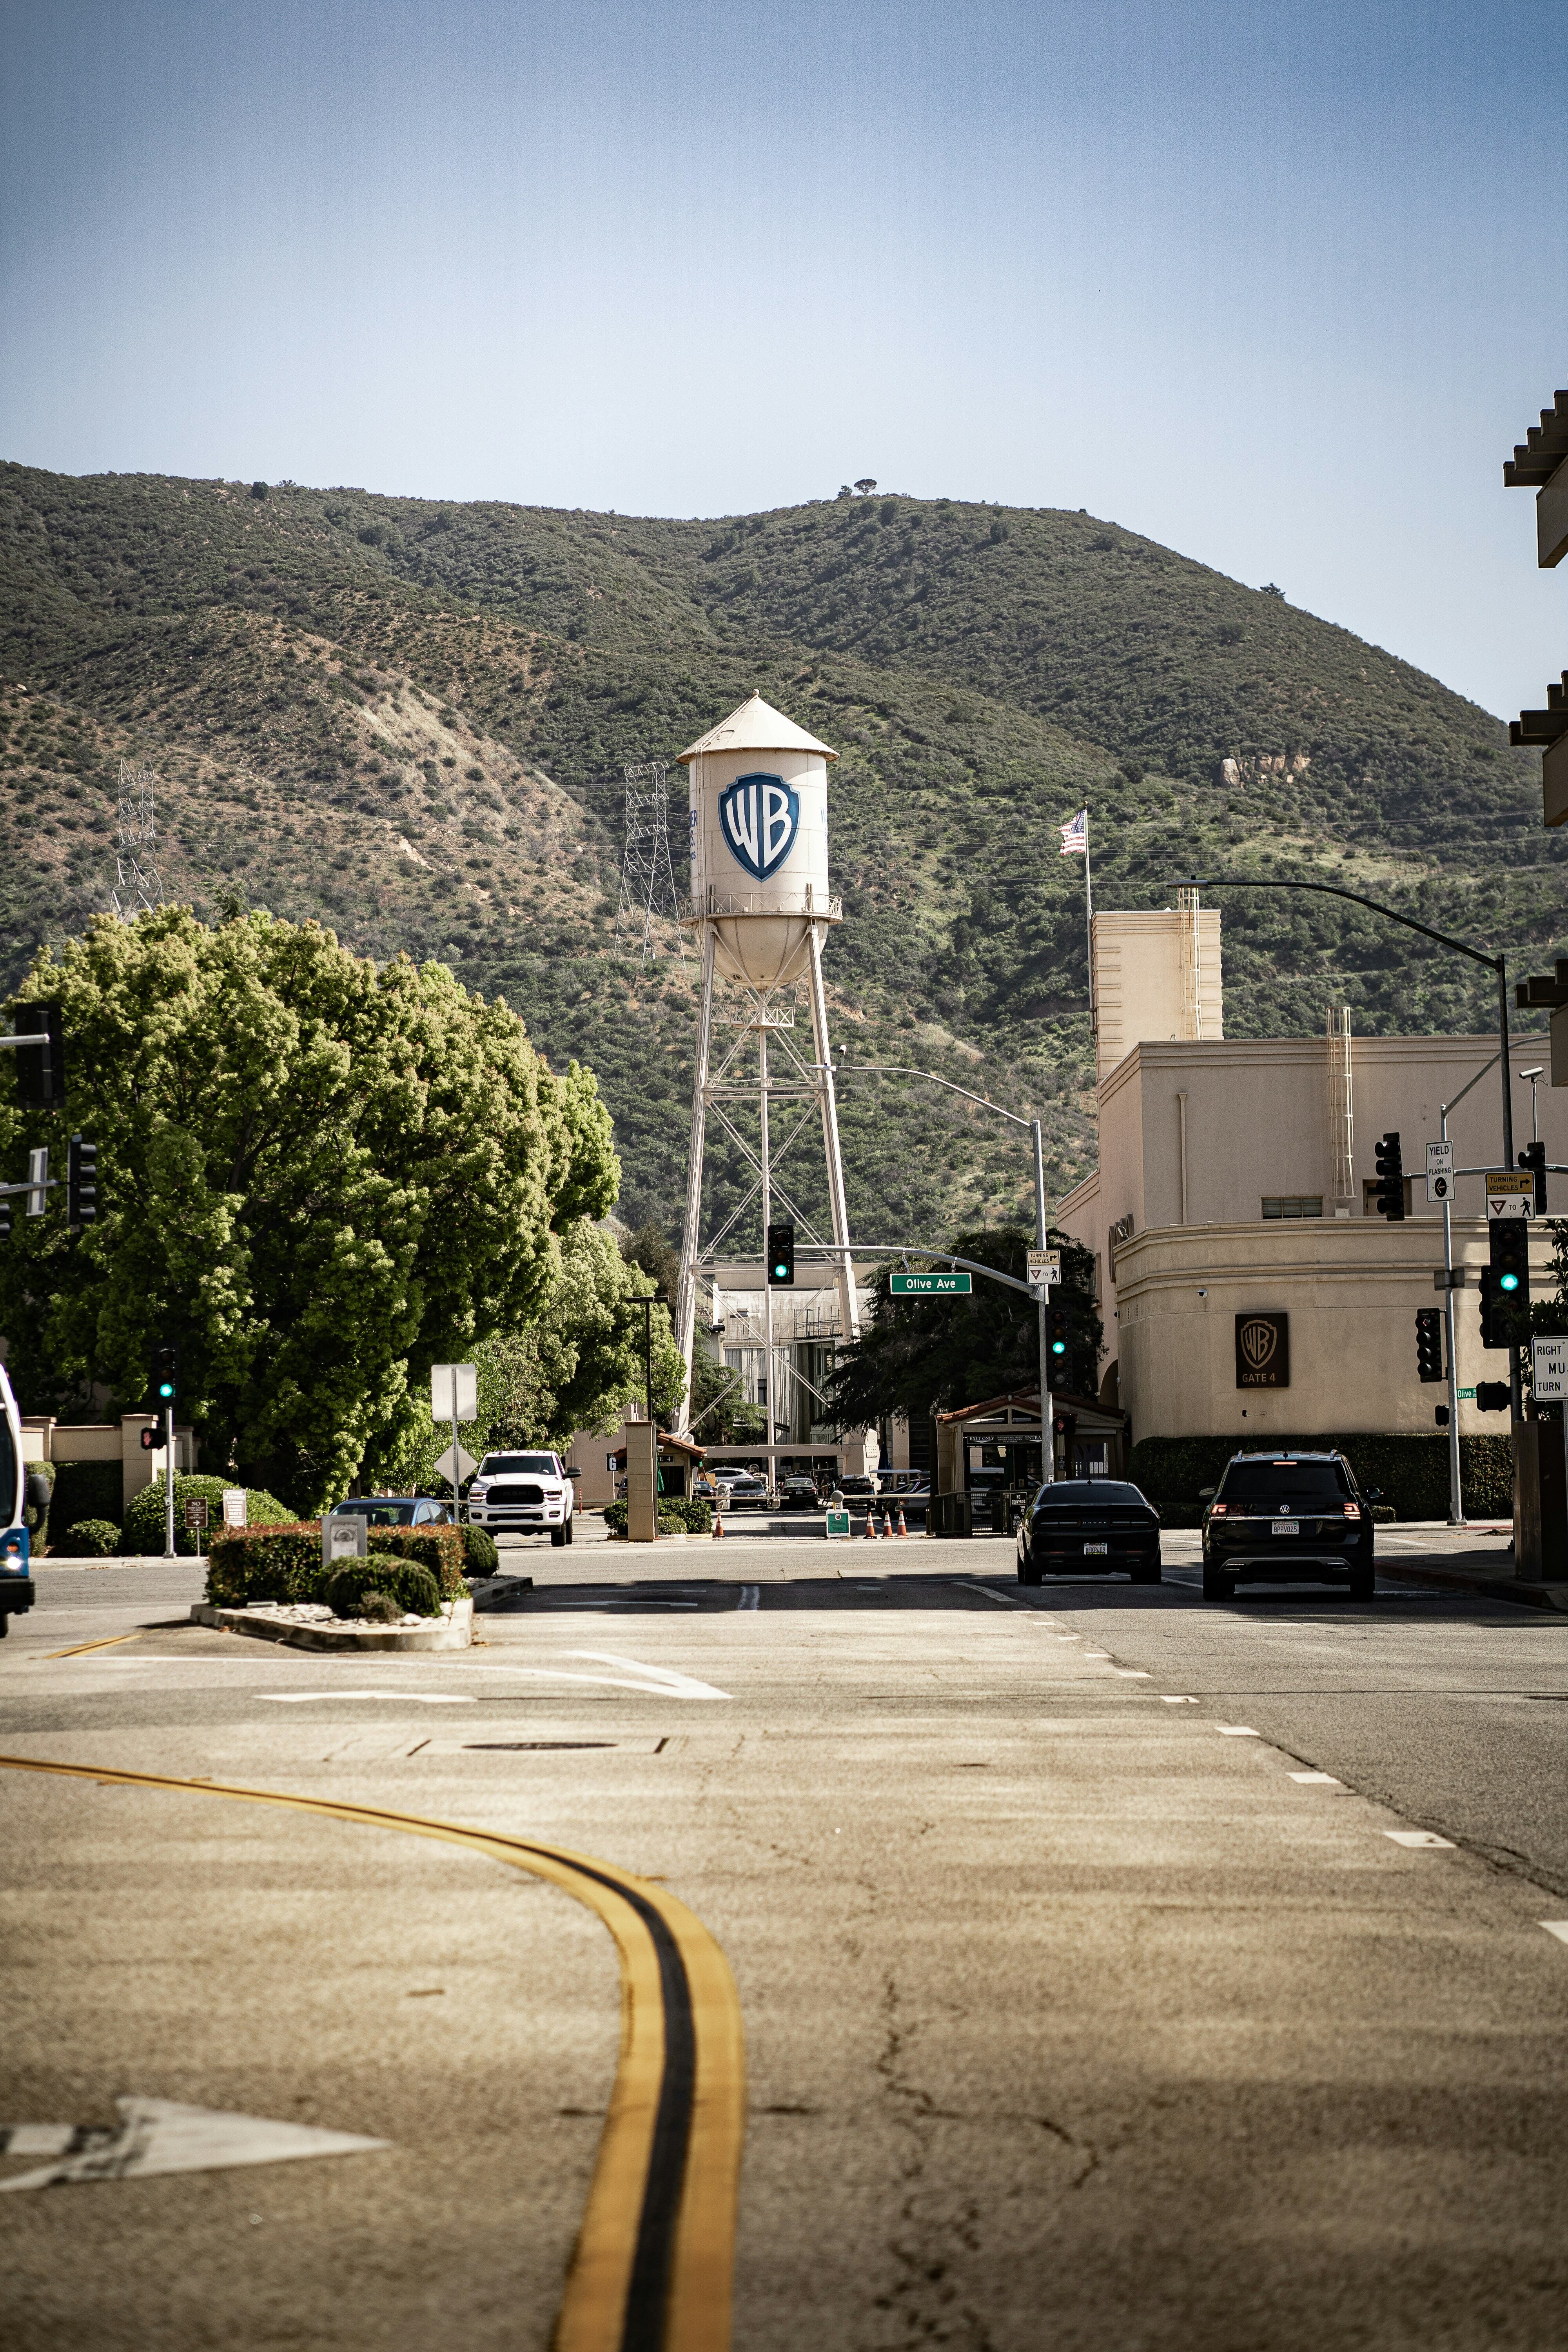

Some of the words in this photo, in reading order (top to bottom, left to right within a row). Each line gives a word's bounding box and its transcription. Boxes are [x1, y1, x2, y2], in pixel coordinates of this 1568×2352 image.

[726, 785, 792, 868] WB
[1429, 1145, 1449, 1156] YIELD
[906, 1279, 932, 1289] Olive
[936, 1278, 956, 1288] Ave
[1245, 1326, 1270, 1361] WB
[1537, 1346, 1561, 1355] RIGHT
[1549, 1363, 1568, 1374] MU
[1242, 1374, 1267, 1382] GATE
[1269, 1373, 1276, 1381] 4
[1537, 1382, 1560, 1391] TURN
[609, 1457, 616, 1470] G
